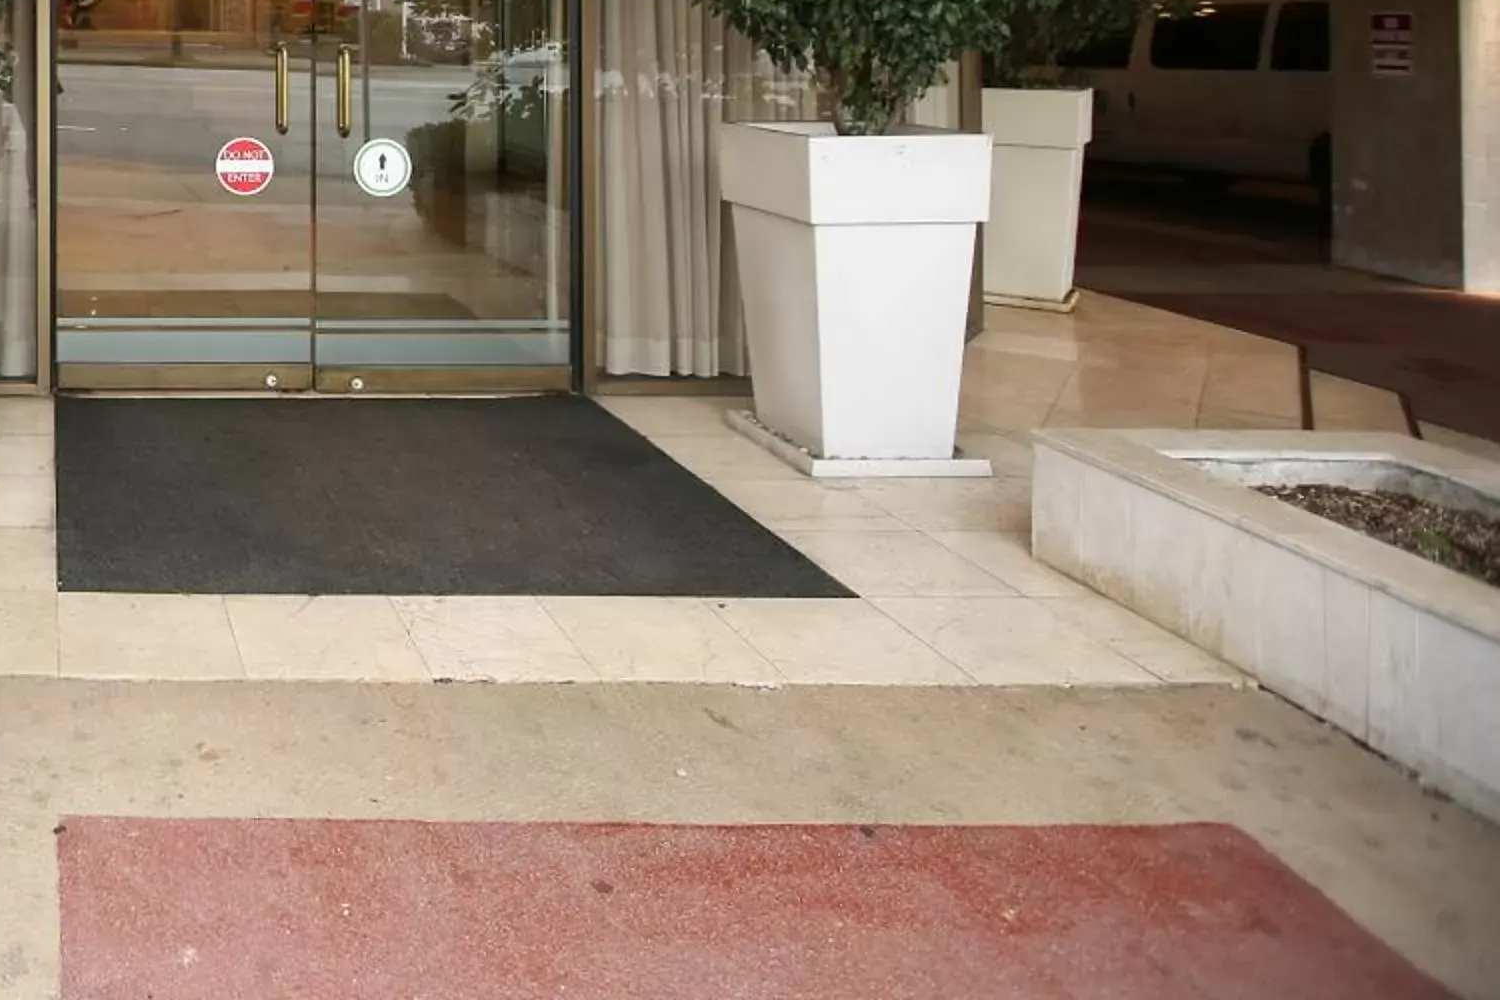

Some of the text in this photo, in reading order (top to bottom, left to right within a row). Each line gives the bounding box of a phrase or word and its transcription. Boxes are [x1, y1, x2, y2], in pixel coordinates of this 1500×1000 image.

[223, 150, 266, 160] DO NOT
[227, 172, 263, 183] ENTER
